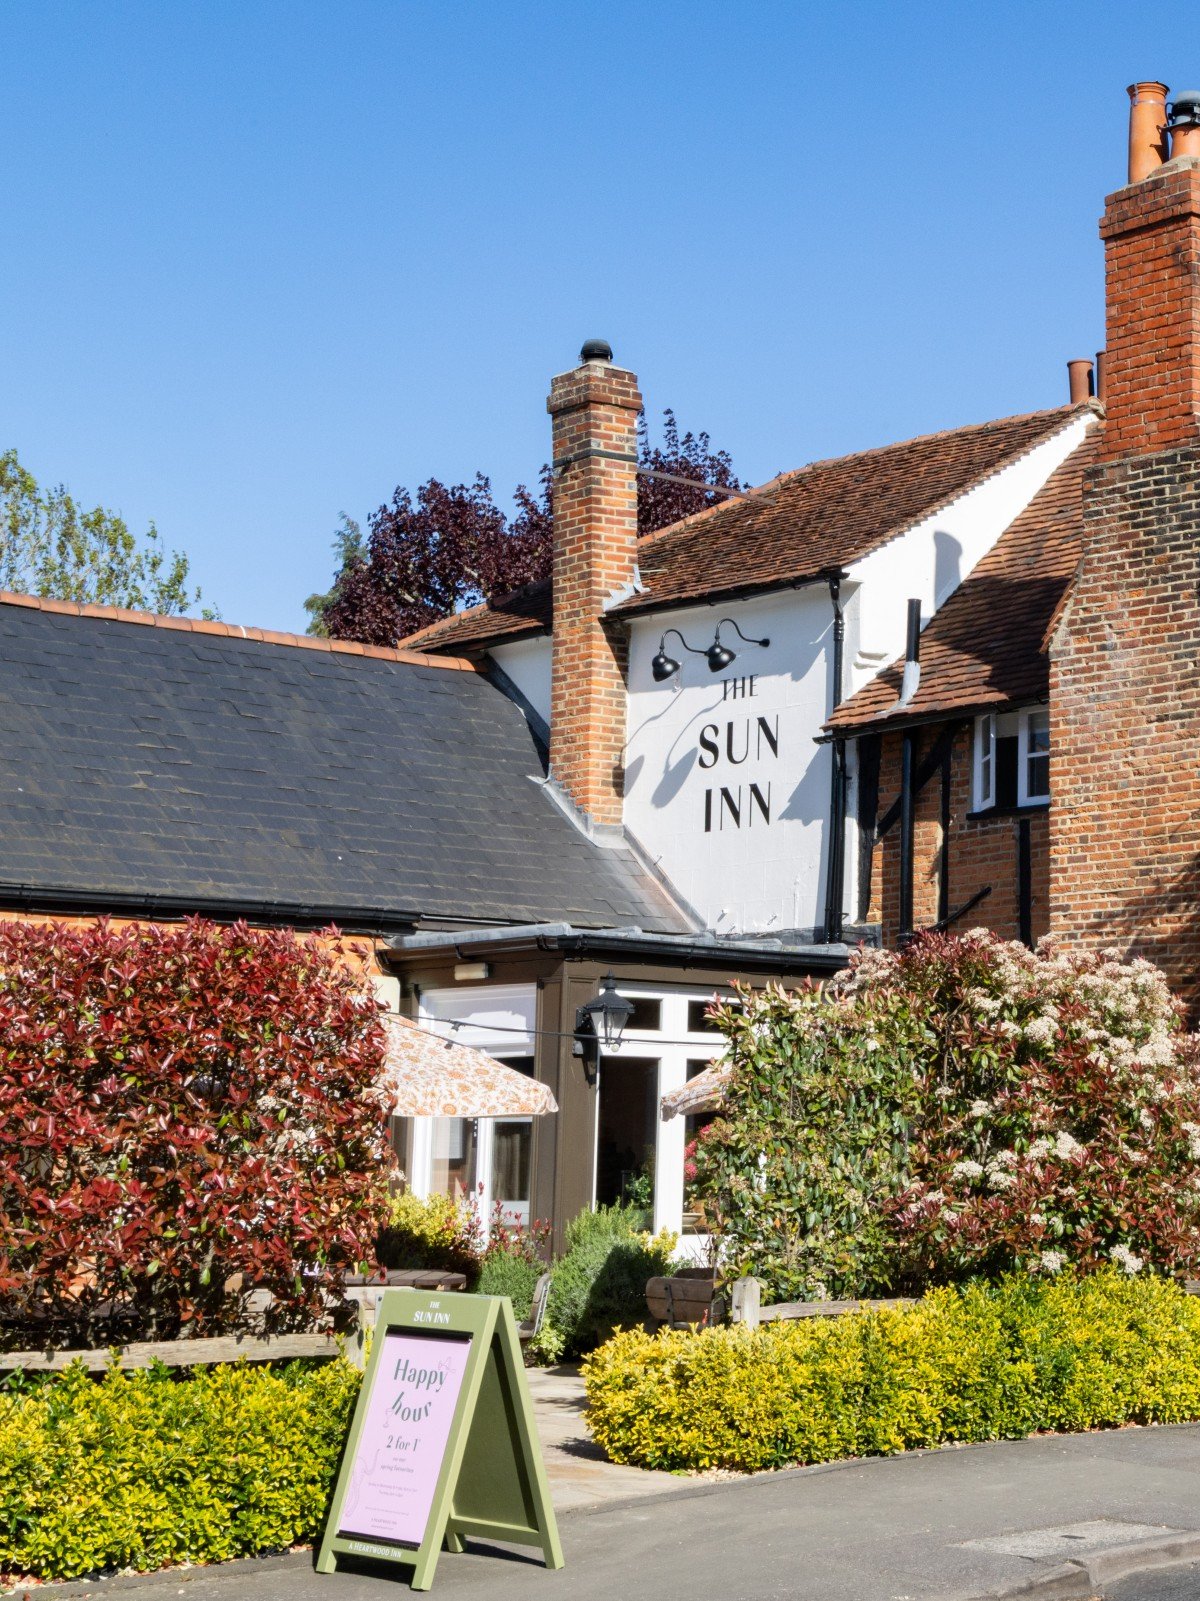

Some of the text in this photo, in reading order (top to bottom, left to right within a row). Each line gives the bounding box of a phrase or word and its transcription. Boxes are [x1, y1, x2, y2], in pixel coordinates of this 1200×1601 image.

[720, 674, 759, 701] THE
[698, 714, 779, 769] SUN
[704, 781, 771, 832] INN
[413, 1310, 451, 1324] SUN INN
[429, 1301, 441, 1309] THE
[393, 1358, 448, 1393] Happy
[391, 1391, 432, 1422] hour
[386, 1435, 394, 1449] 2
[395, 1436, 411, 1451] for
[354, 1542, 390, 1556] HEARTWOOD
[390, 1549, 402, 1558] INN
